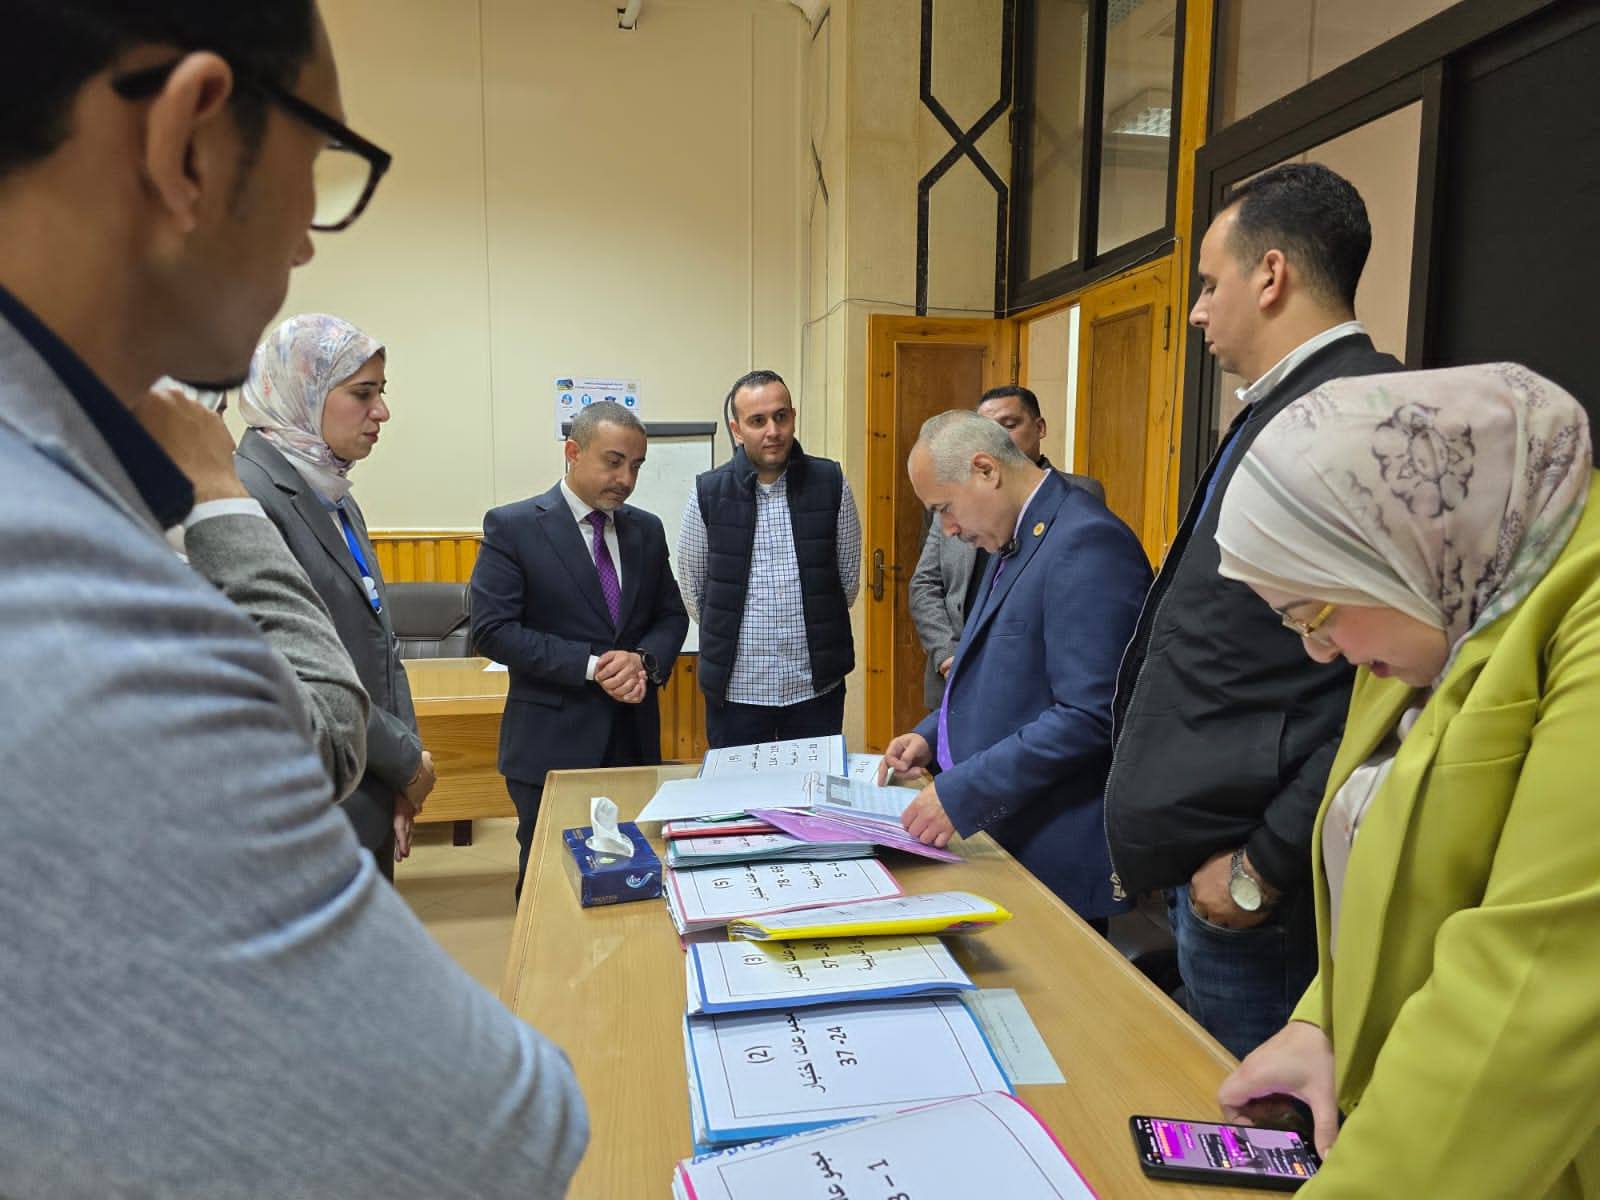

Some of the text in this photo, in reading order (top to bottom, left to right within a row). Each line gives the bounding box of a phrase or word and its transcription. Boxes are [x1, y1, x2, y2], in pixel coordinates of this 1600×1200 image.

[712, 877, 734, 889] (5)
[776, 878, 792, 888] 78
[743, 953, 768, 966] (3)
[820, 959, 839, 969] 57
[744, 1045, 775, 1064] (2)
[786, 1011, 826, 1093] مجموعات اختبار
[836, 1050, 858, 1067] 37
[867, 1159, 889, 1171] 1
[811, 1151, 848, 1200] مجموعا
